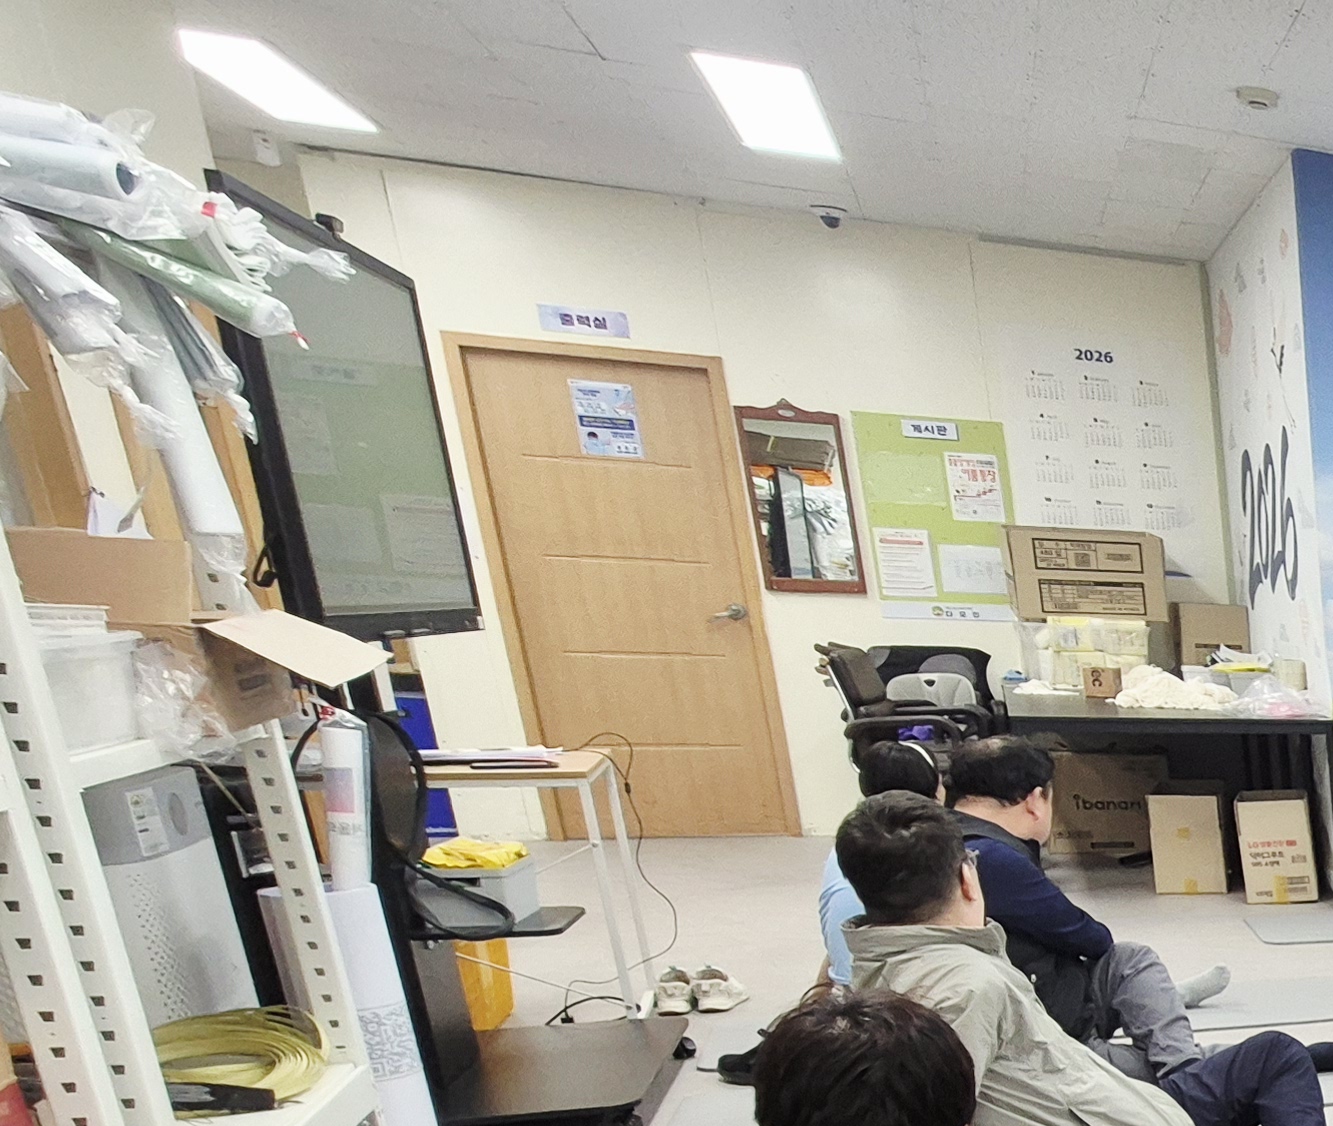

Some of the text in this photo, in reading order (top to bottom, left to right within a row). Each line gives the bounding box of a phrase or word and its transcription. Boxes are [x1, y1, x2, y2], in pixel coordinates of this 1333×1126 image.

[1074, 348, 1114, 364] 2026
[911, 423, 948, 437] 게시판
[1241, 424, 1298, 611] 2026
